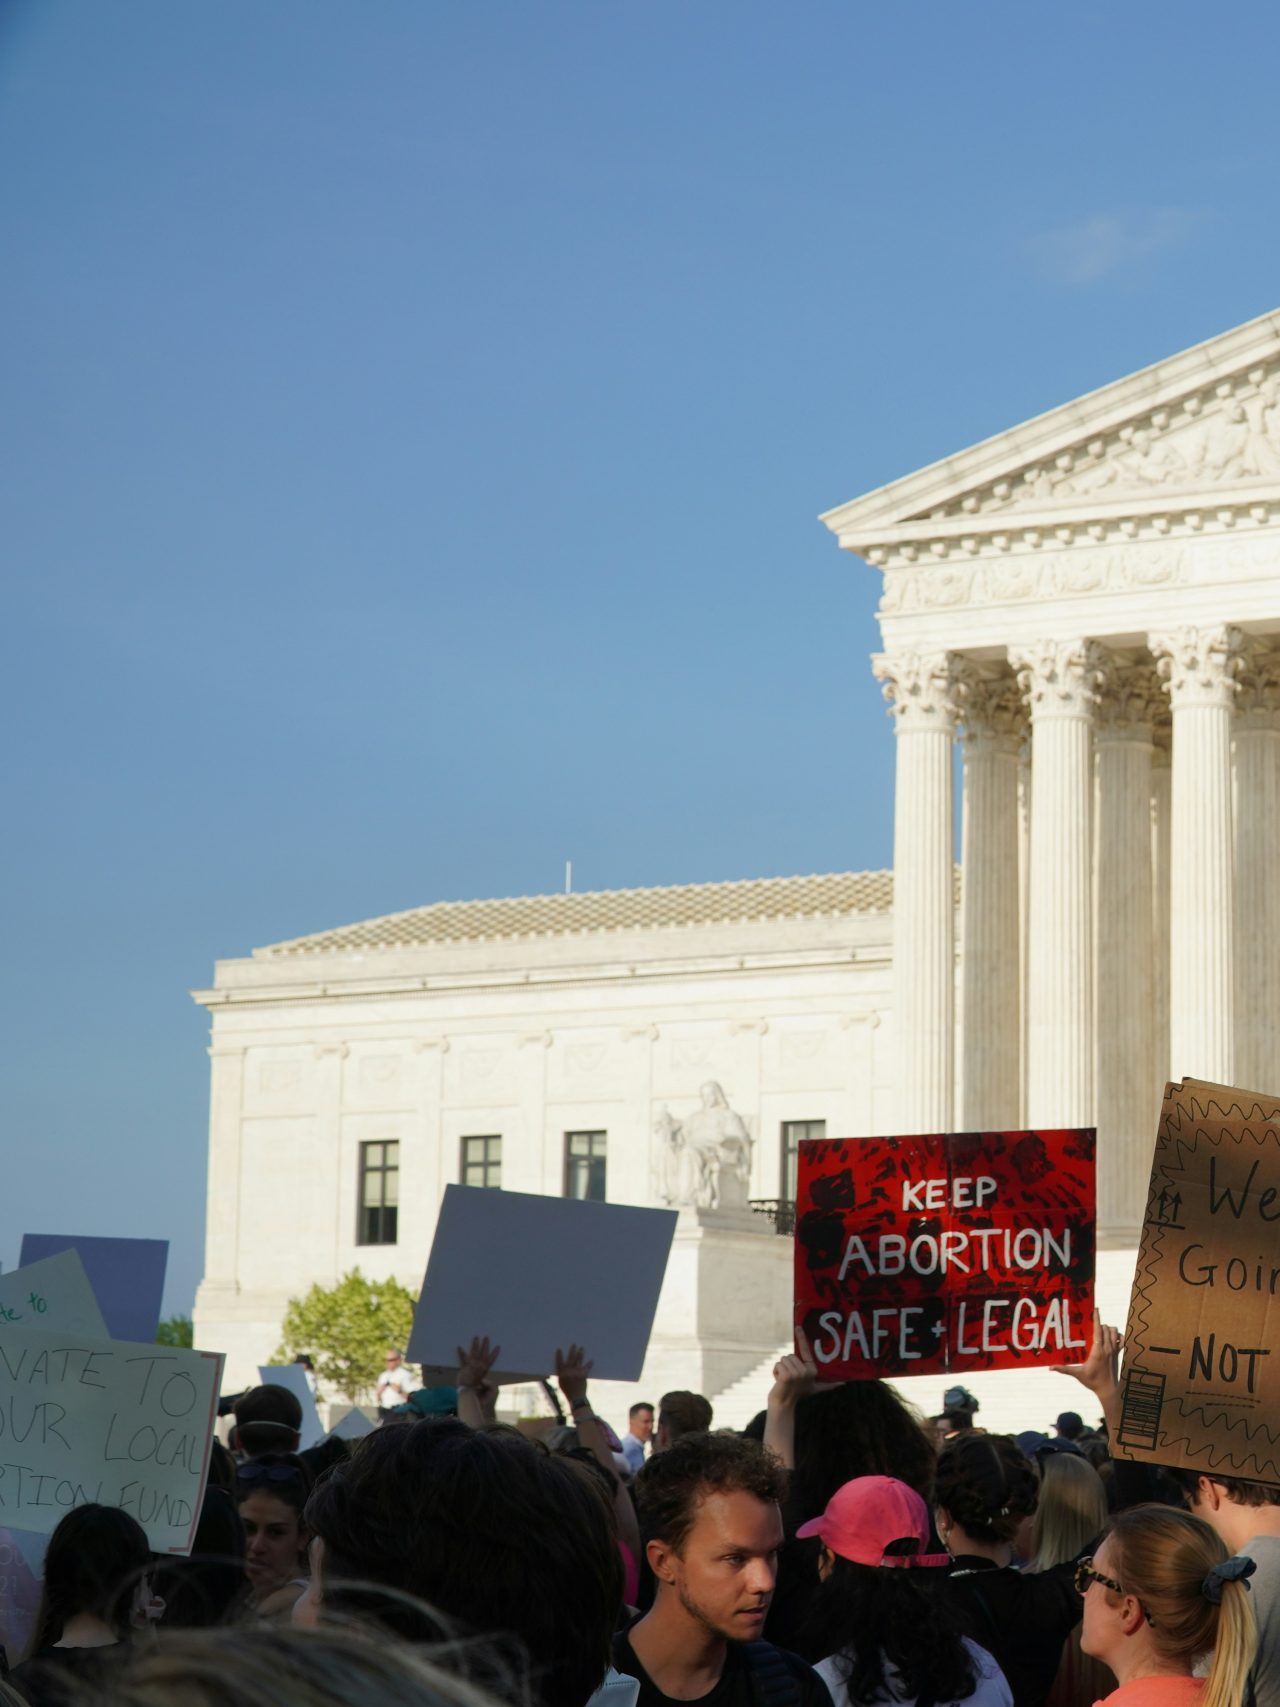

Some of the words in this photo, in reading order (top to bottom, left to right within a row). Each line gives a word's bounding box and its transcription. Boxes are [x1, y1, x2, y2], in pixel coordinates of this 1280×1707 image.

[902, 1175, 997, 1212] KEEP
[837, 1227, 1071, 1281] ABORTION
[813, 1307, 924, 1364] SAFE
[956, 1297, 1087, 1354] LEGAL
[125, 1355, 198, 1418] TO
[0, 1396, 72, 1450] UR
[104, 1412, 201, 1476] LOCAL
